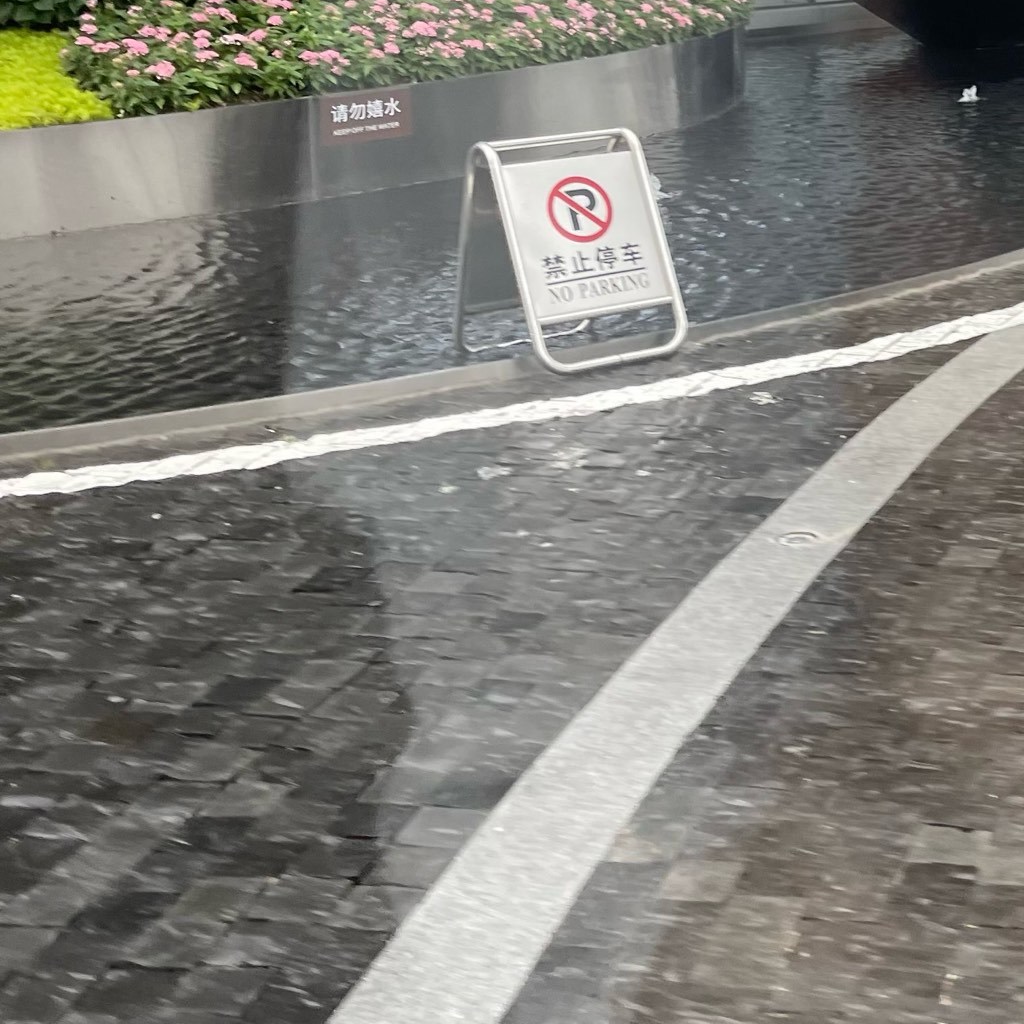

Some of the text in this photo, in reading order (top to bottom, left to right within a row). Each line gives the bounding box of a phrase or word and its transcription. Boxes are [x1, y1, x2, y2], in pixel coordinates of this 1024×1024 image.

[330, 97, 401, 123] 请勿嬉水
[542, 242, 643, 279] 禁止停车
[548, 272, 650, 305] NO PARKING
